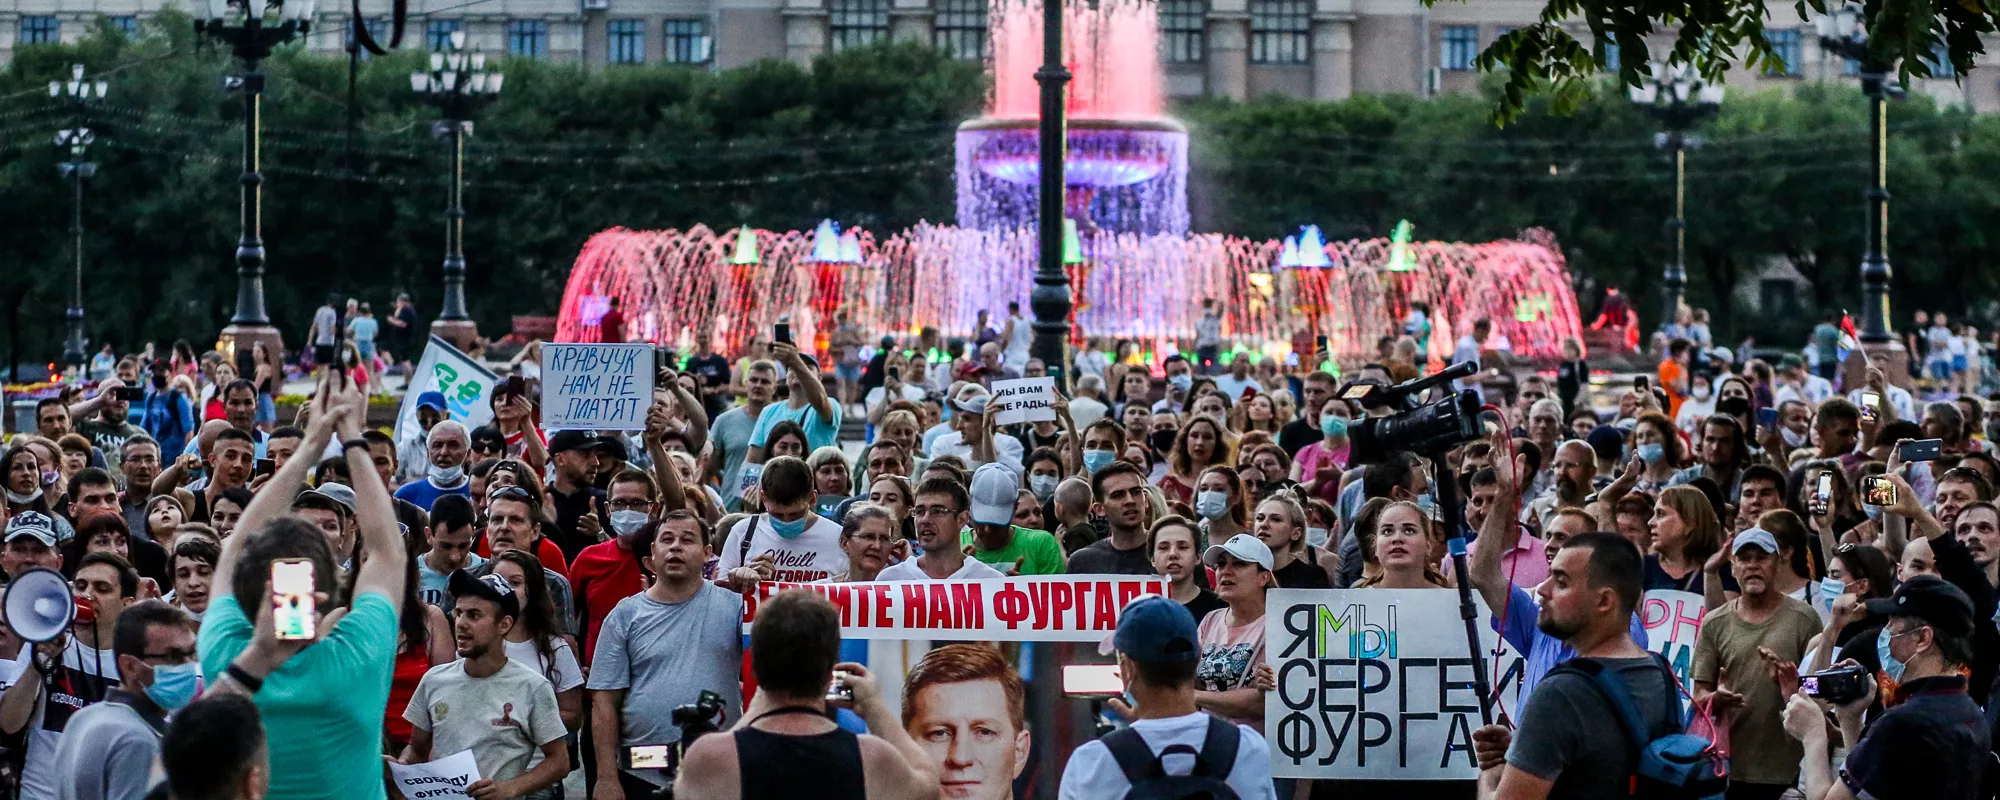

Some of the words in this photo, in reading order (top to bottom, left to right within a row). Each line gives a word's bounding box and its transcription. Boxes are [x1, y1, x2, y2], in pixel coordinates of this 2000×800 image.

[551, 347, 642, 374] КРАВЧУК
[559, 375, 600, 395] НАМ
[607, 375, 635, 396] НЕ
[996, 387, 1015, 397] МЫ
[1019, 385, 1043, 395] ВАМ
[565, 398, 640, 422] ПЛАТЯТ
[1016, 400, 1048, 410] РАДЫ
[743, 579, 893, 628] ВИТЕ
[901, 582, 984, 629] НАМ
[1277, 648, 1525, 713] СЕРГЕЙ
[1277, 711, 1512, 768] ФУРГА
[404, 773, 469, 788] СВОБОДУ
